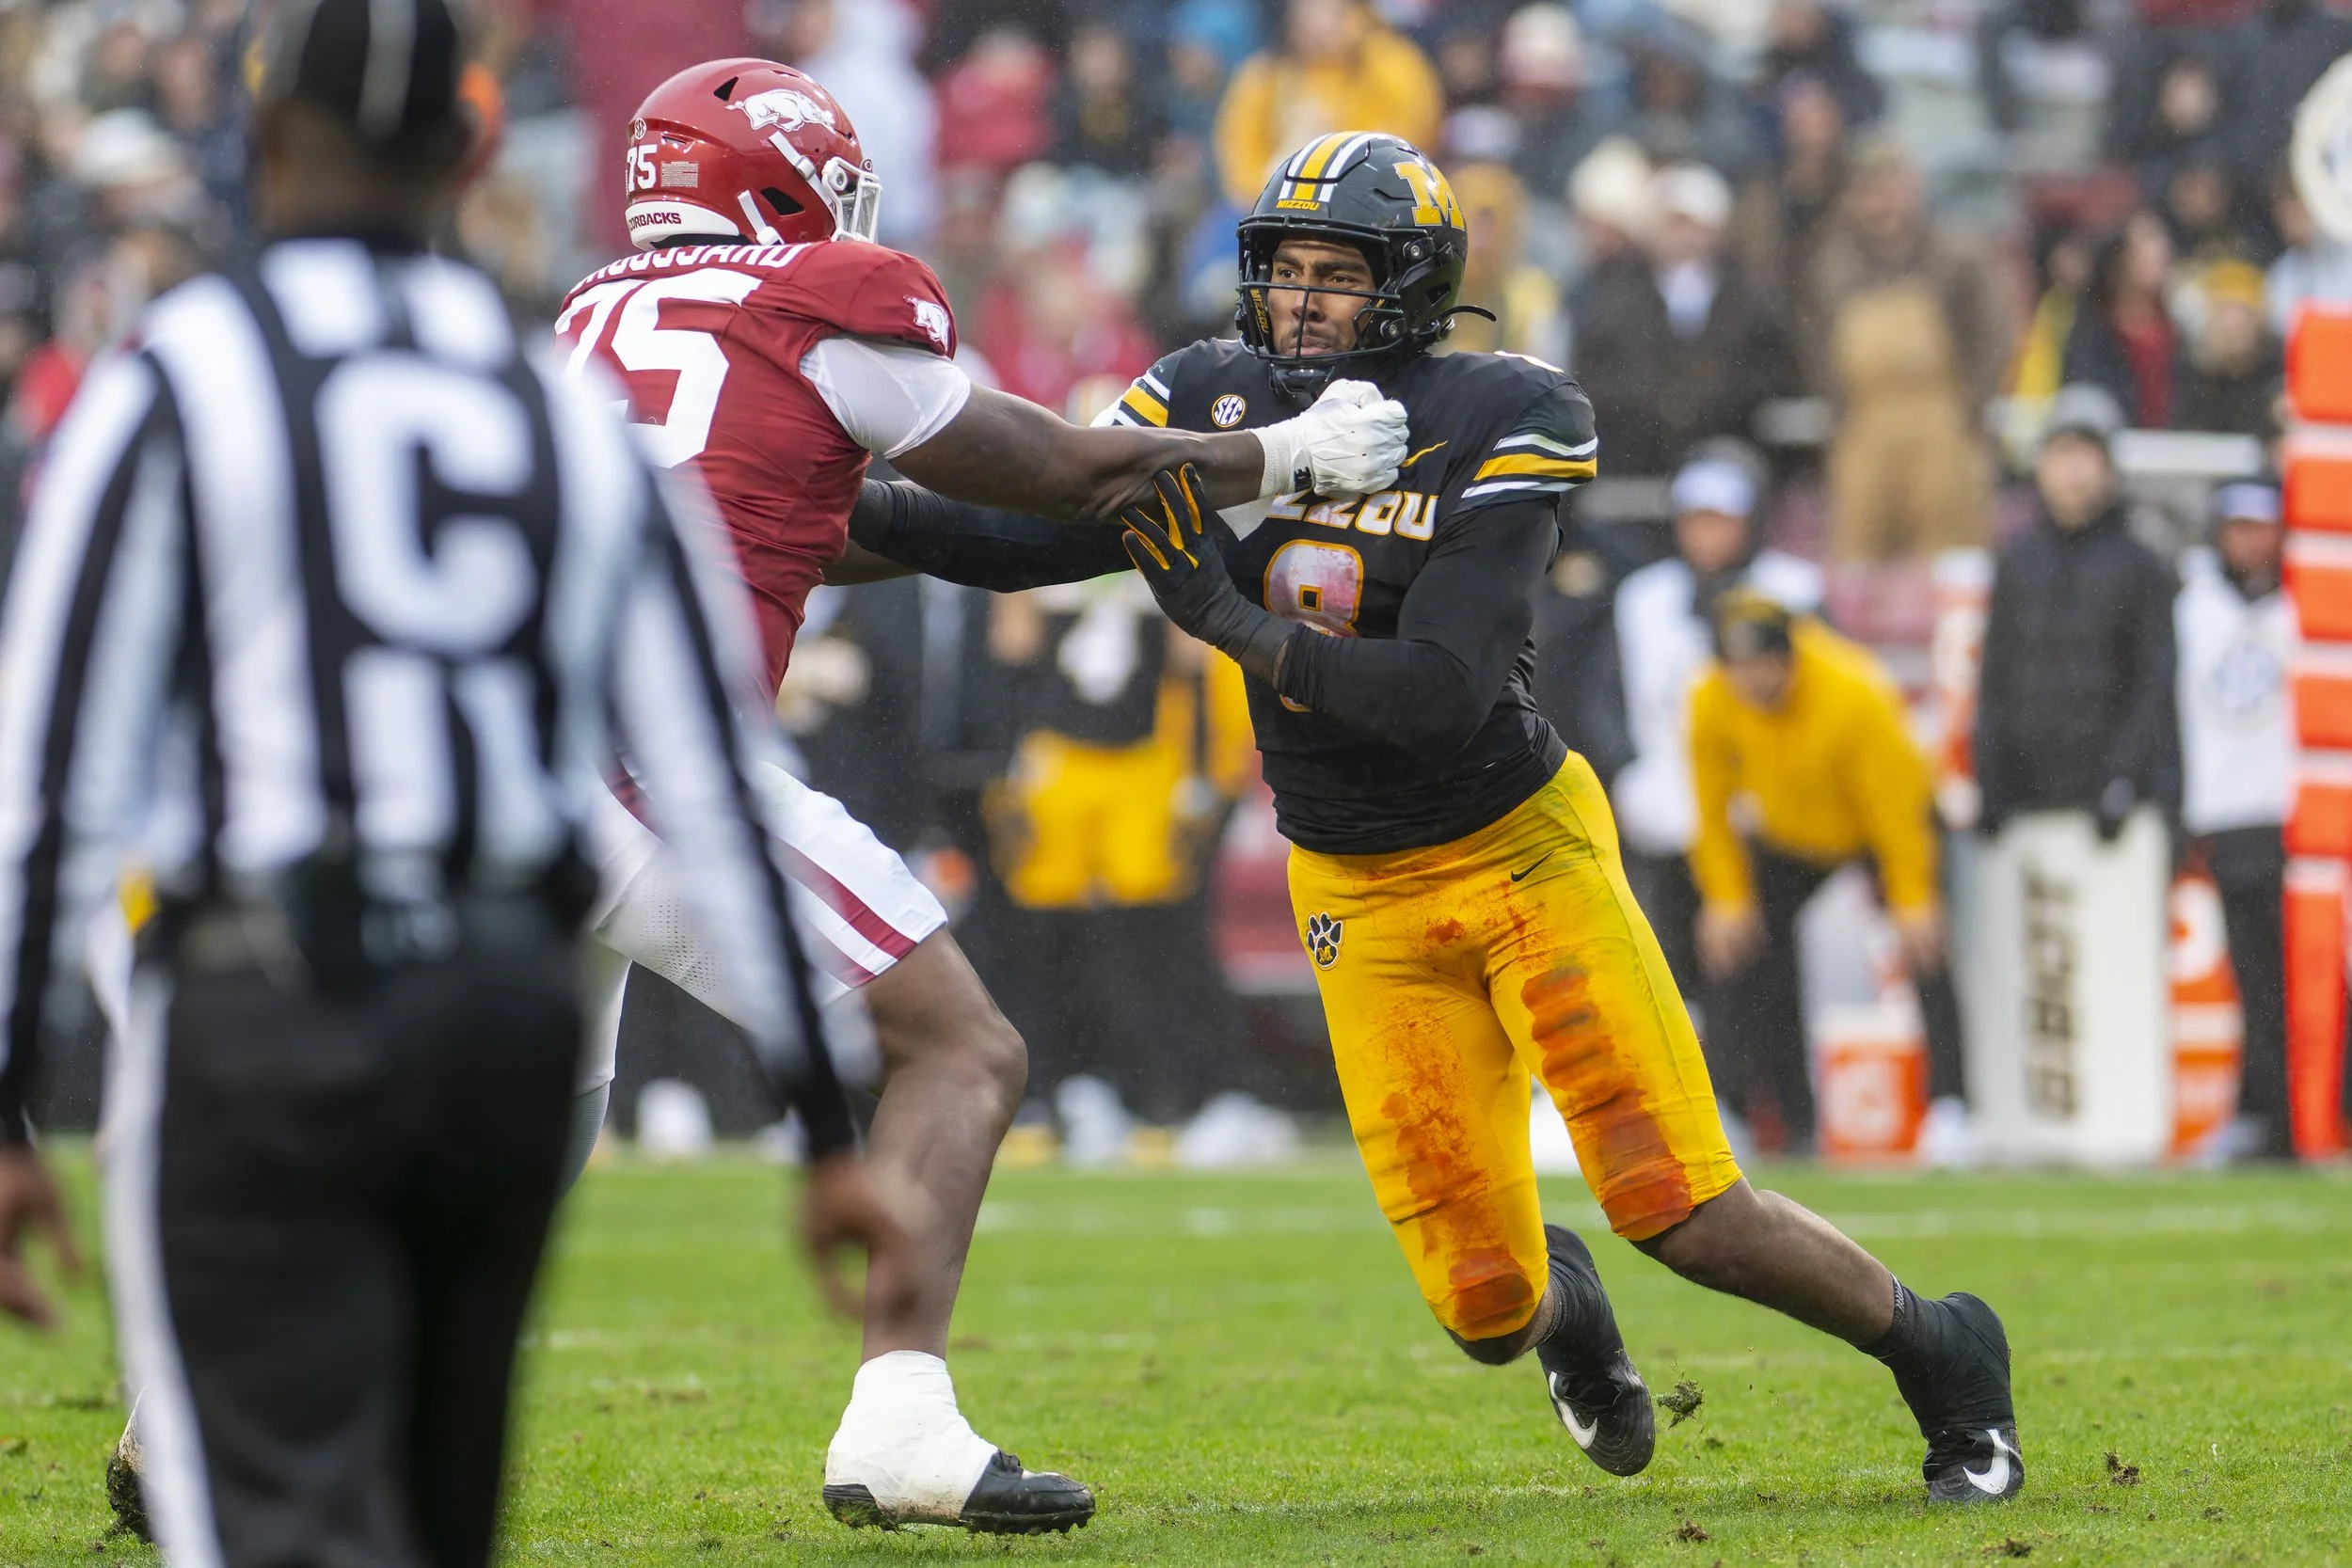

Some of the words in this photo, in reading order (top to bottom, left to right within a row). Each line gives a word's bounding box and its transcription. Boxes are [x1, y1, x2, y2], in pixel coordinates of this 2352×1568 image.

[627, 144, 658, 192] 75
[1276, 199, 1321, 211] MIZZOU
[1392, 162, 1465, 231] M
[629, 213, 682, 230] ZORBACKS
[1250, 289, 1269, 333] MIZZOU
[1214, 396, 1243, 425] SEC
[317, 354, 536, 652] C
[1266, 488, 1438, 541] ZZOU
[1318, 945, 1333, 963] M
